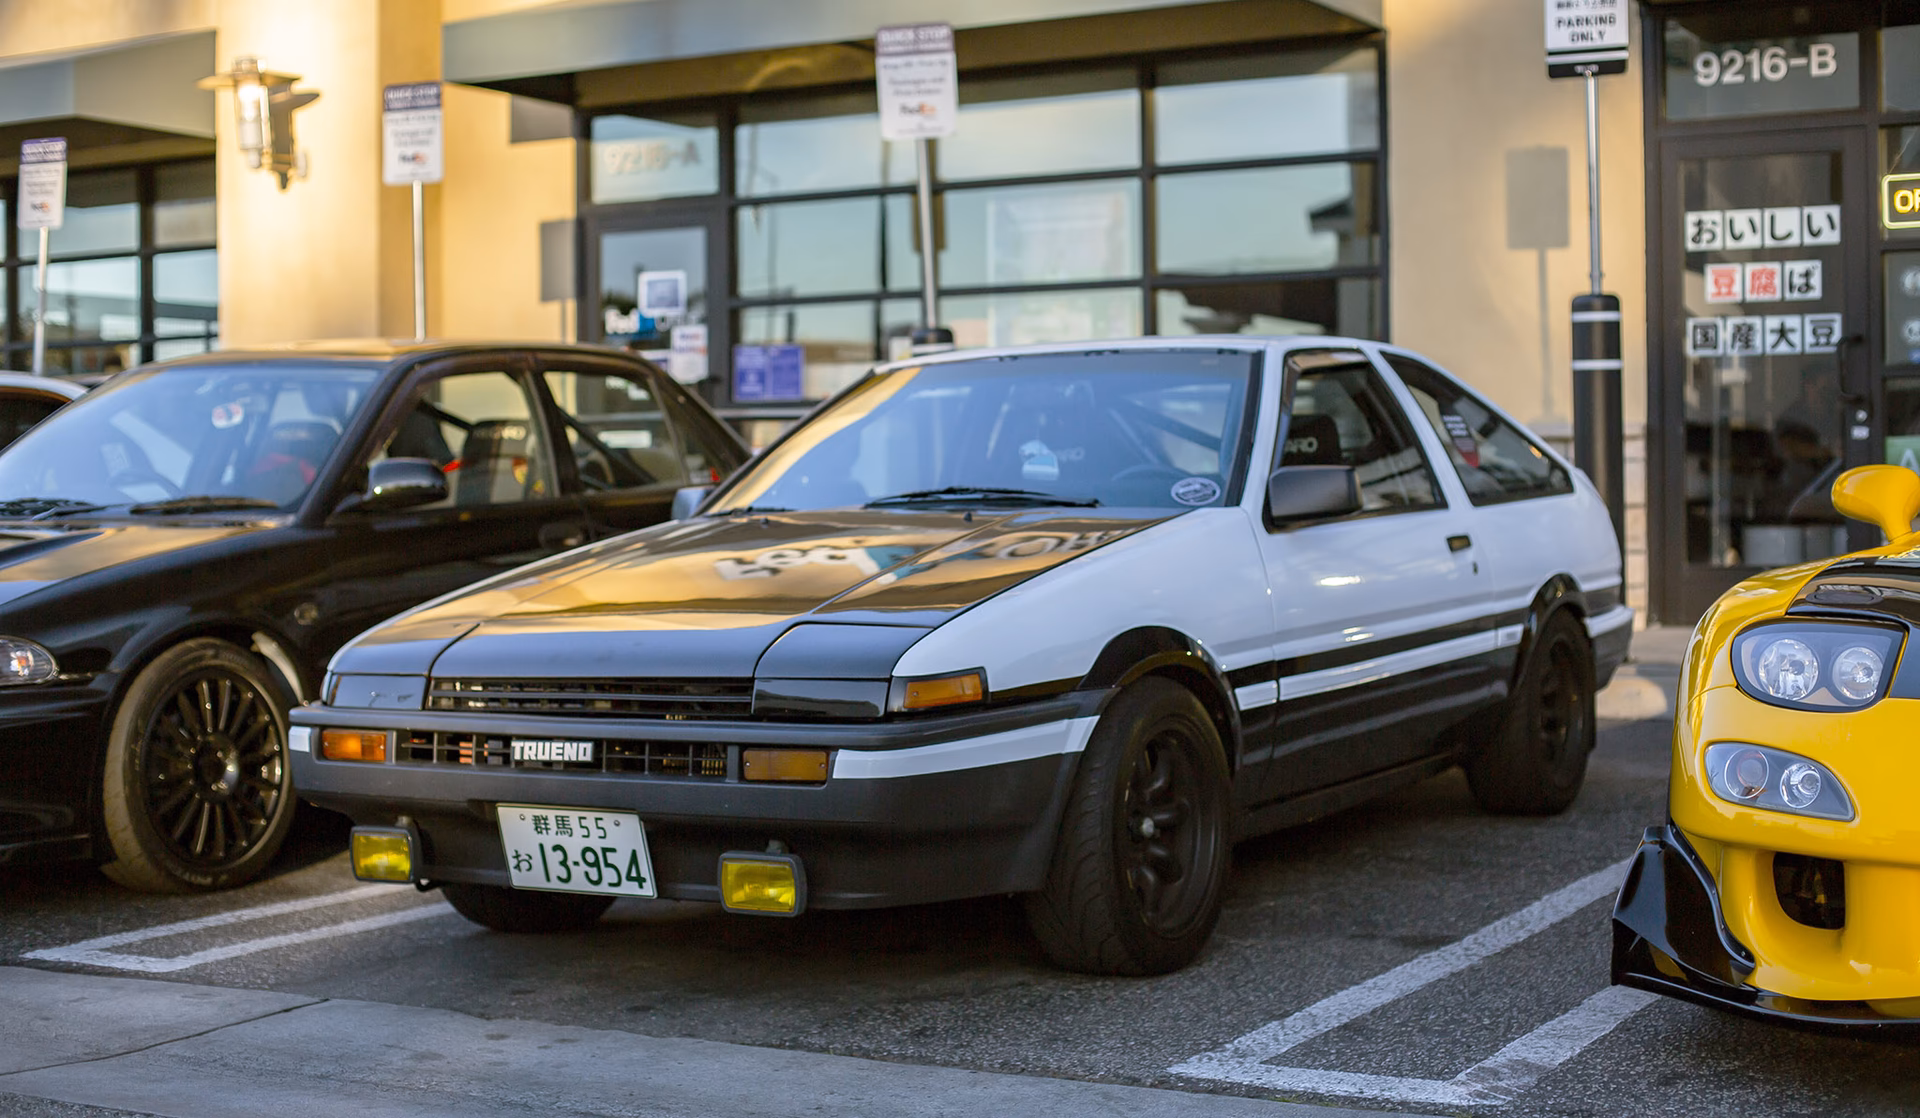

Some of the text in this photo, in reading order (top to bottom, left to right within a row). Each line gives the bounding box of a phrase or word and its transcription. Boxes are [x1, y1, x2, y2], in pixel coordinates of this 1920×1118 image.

[1556, 14, 1616, 28] PARKING
[1570, 30, 1606, 44] ONLY
[1694, 43, 1837, 87] 9216-B
[1690, 211, 1836, 245] おいしい
[1711, 266, 1818, 298] 豆腐ば
[1692, 318, 1842, 350] 国産大豆
[511, 740, 594, 762] TRUENO
